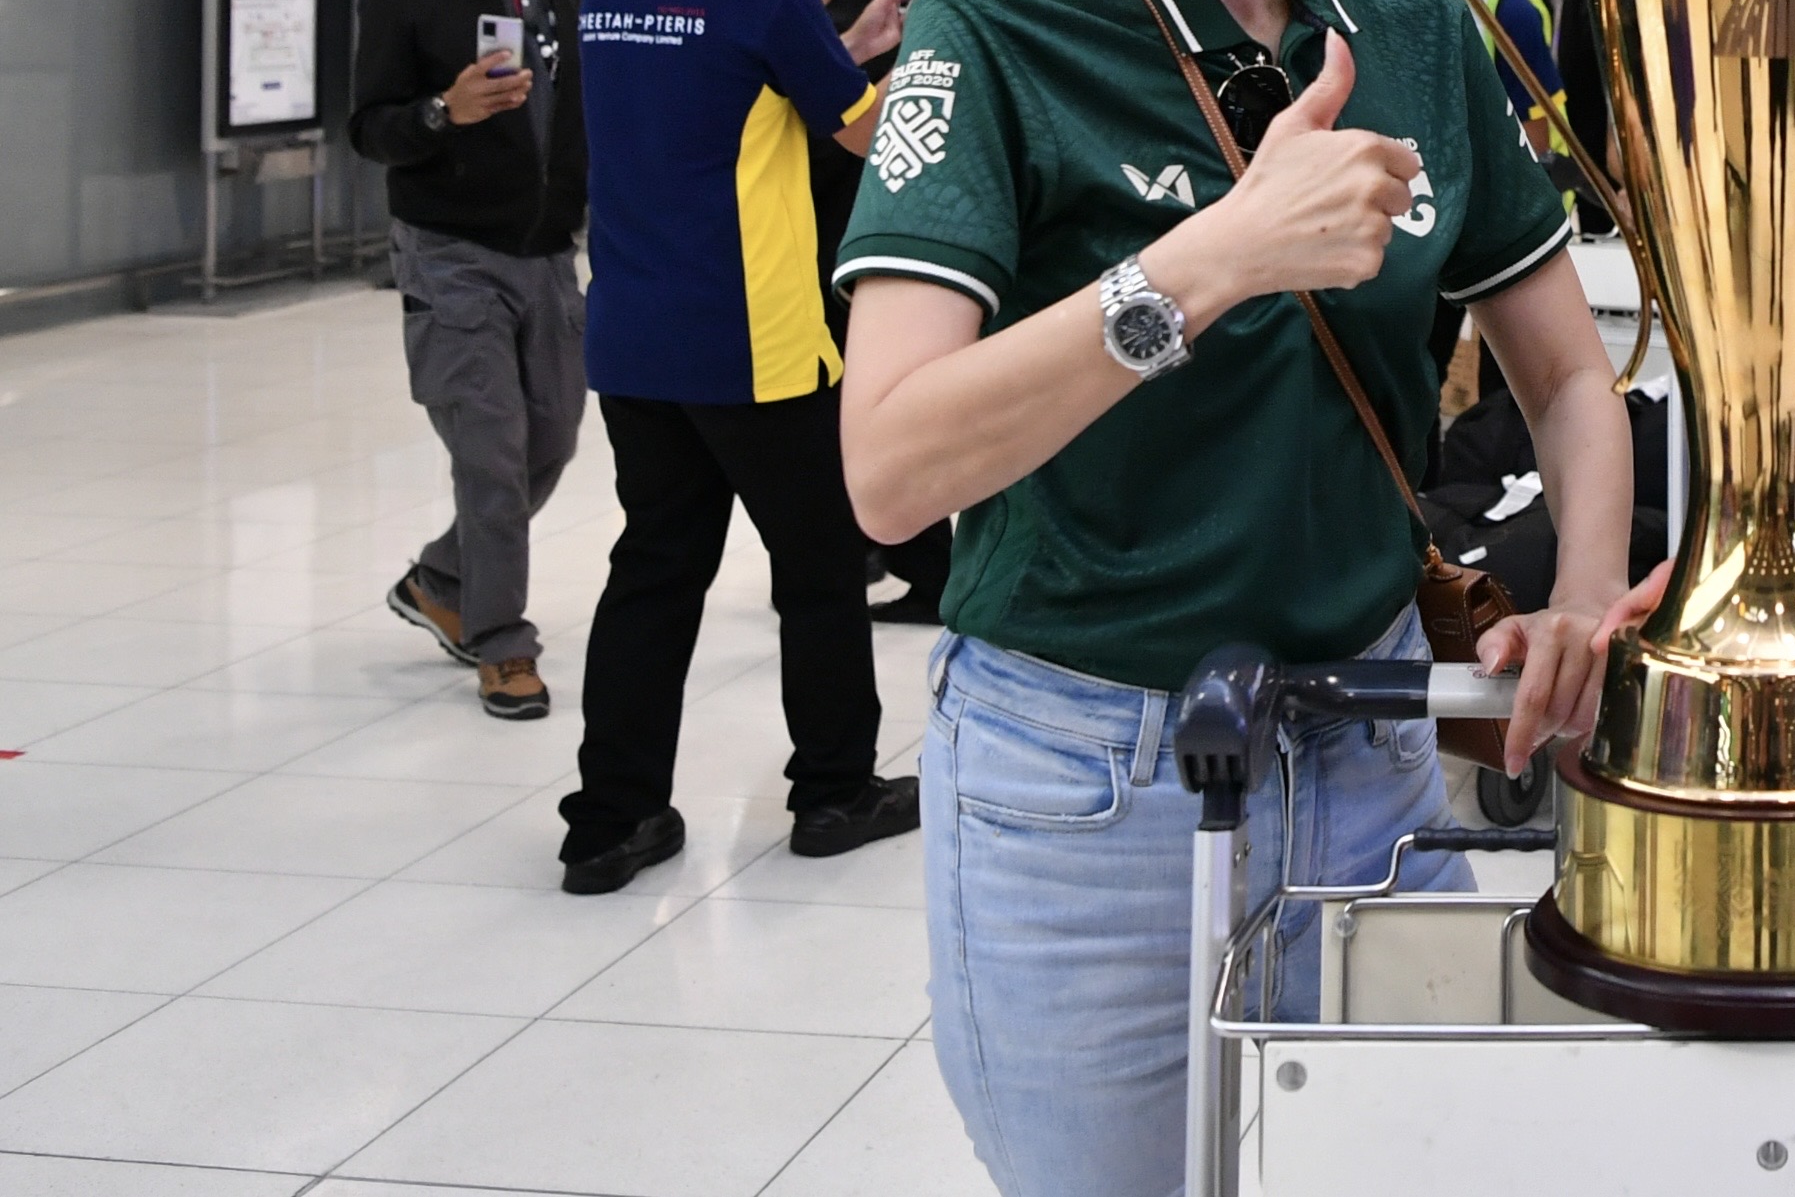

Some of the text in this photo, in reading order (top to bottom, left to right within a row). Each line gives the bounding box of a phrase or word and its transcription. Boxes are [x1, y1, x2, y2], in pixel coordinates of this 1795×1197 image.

[909, 49, 936, 61] AFF
[891, 60, 961, 81] SUZUKI
[889, 75, 954, 91] CUP 2020
